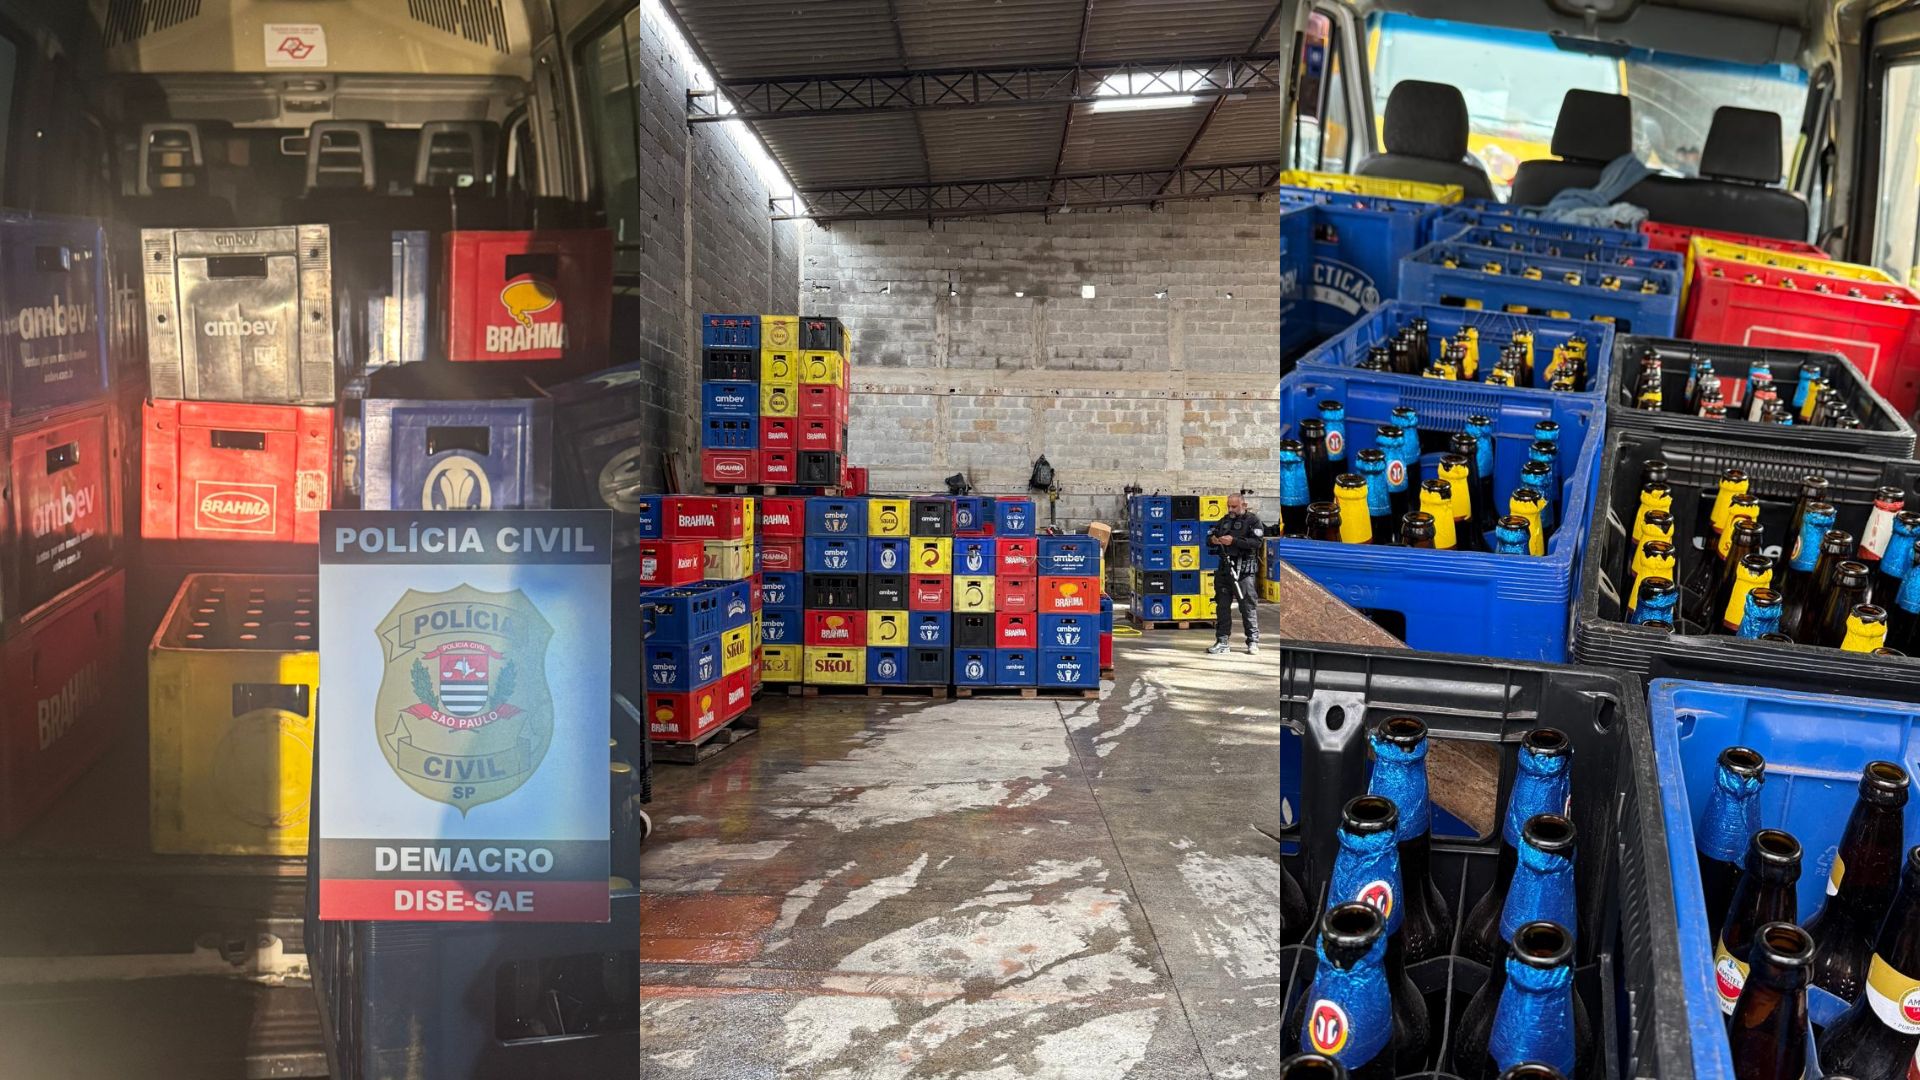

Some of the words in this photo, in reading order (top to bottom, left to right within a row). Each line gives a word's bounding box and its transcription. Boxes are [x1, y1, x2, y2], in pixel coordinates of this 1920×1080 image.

[1313, 263, 1365, 299] CTICA
[19, 294, 88, 340] ambev
[204, 317, 278, 337] ambev
[485, 322, 569, 353] BRAHMA
[715, 395, 745, 403] ambev
[806, 432, 827, 440] BRAHMA
[715, 463, 745, 472] BRAHMA
[32, 484, 96, 539] ambev
[200, 499, 271, 516] BRAHMA
[640, 516, 652, 524] bev
[678, 514, 715, 527] BRAHMA
[763, 514, 790, 525] RAHMA
[335, 522, 484, 553] POLÍCIA
[496, 527, 595, 553] CIVIL
[762, 552, 788, 561] RAHMA
[1053, 553, 1086, 562] ambev
[1054, 597, 1084, 607] BRAHMA
[414, 605, 514, 635] POLÍCIA
[1004, 628, 1027, 637] BRAHMA
[726, 640, 746, 659] SKOL
[652, 663, 677, 671] ambev
[699, 655, 713, 666] ambev
[814, 659, 855, 672] SKOL
[728, 686, 745, 705] BRAHMA
[459, 711, 498, 728] PAULO
[651, 723, 679, 733] BRAHMA
[423, 756, 506, 780] CIVIL
[452, 786, 476, 799] SP
[375, 847, 554, 873] DEMACRO
[394, 889, 534, 912] DISE-SAE
[1718, 966, 1742, 986] AMSTEL
[1721, 1000, 1734, 1012] MAL
